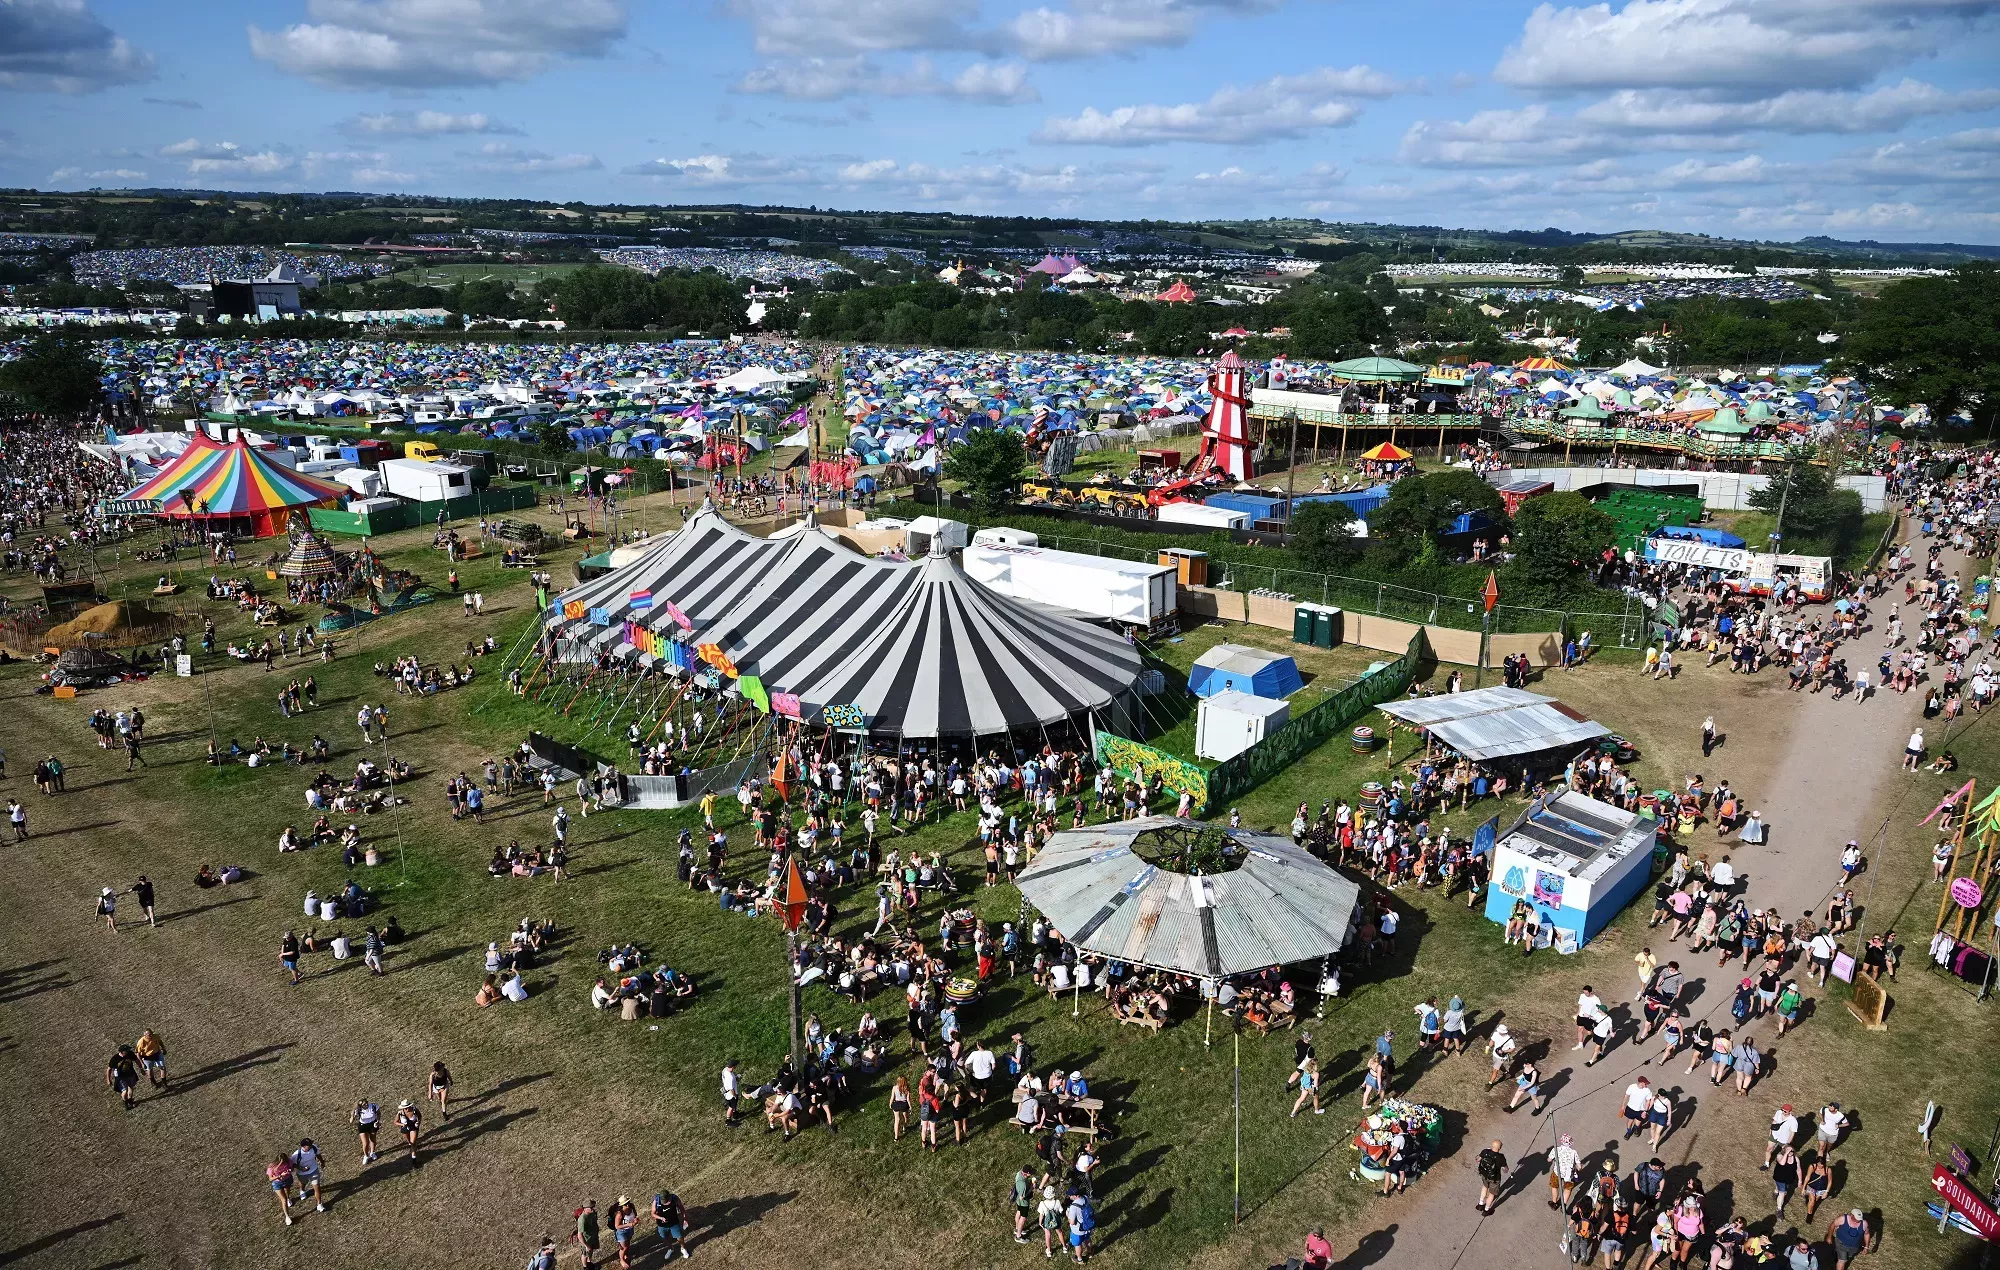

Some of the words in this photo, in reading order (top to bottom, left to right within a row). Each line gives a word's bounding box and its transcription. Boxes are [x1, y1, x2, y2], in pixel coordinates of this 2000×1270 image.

[1428, 367, 1467, 381] ALLEY
[111, 501, 132, 512] PARK
[135, 499, 152, 510] BAR
[1663, 543, 1743, 568] TOILETS
[1969, 888, 1979, 896] YOU
[1955, 896, 1973, 907] WORLD
[1946, 1179, 1998, 1232] SOLIDARITY
